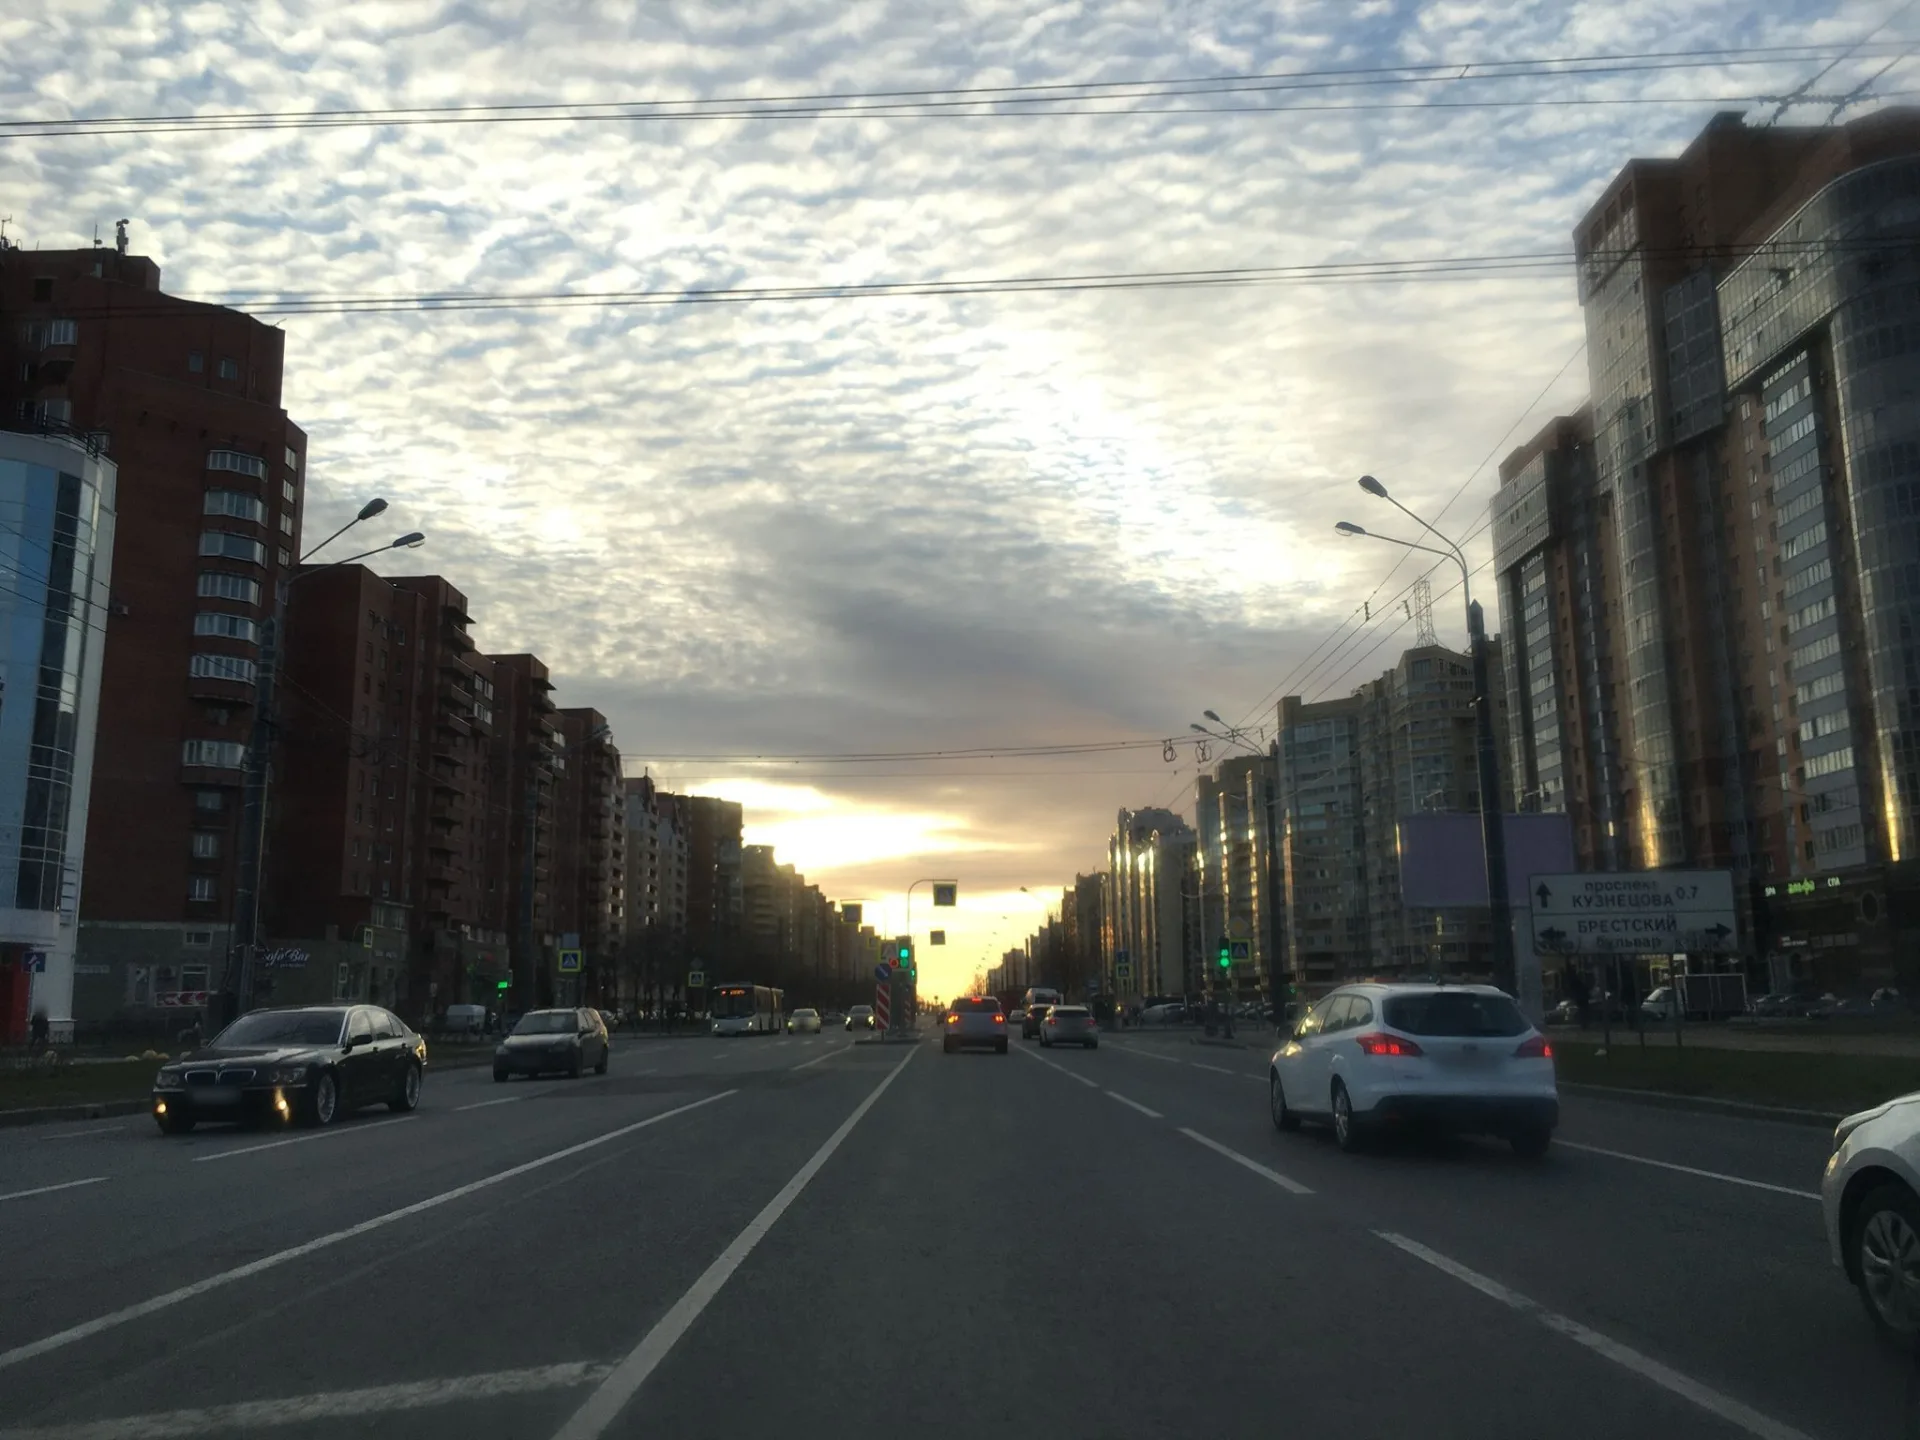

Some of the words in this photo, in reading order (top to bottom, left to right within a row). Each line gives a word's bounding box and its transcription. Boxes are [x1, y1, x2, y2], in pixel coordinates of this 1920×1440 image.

[1585, 880, 1659, 893] проспект
[1572, 894, 1674, 908] КУЗНЕЦОВА
[1578, 914, 1677, 933] БРЕСТСКИЙ
[1596, 935, 1662, 949] бульвар
